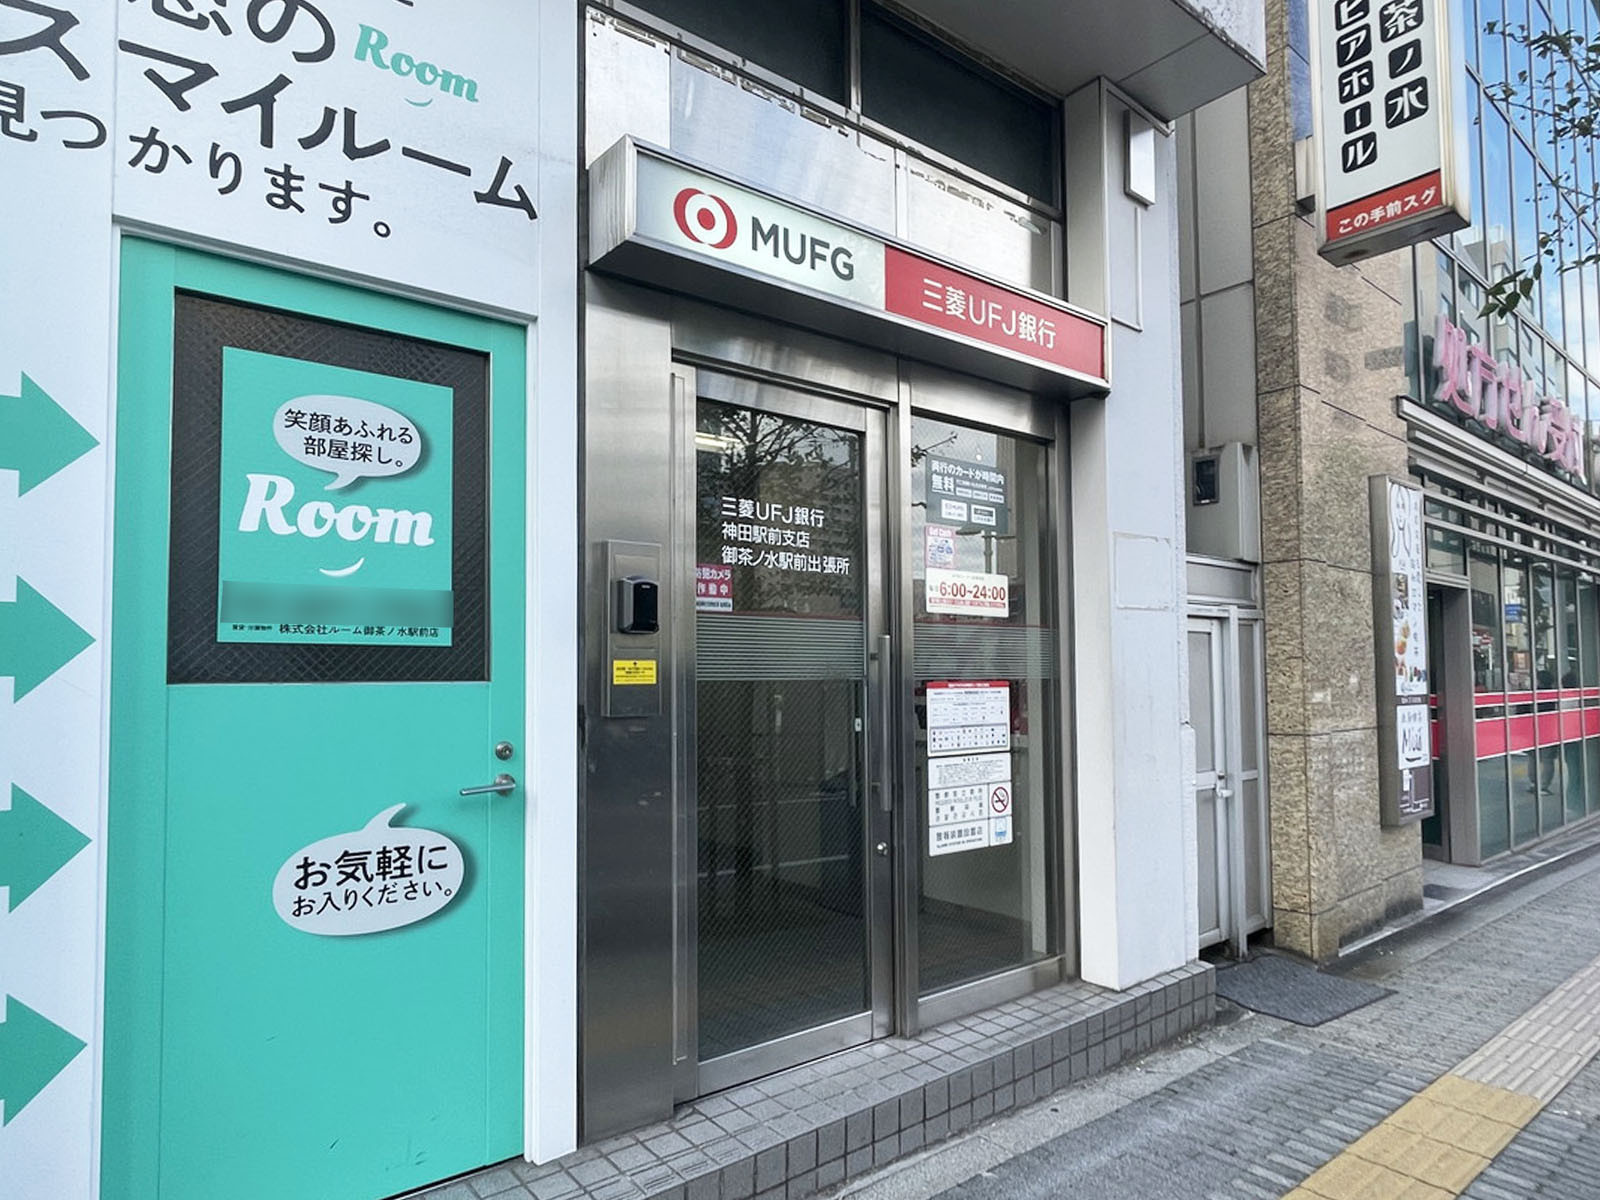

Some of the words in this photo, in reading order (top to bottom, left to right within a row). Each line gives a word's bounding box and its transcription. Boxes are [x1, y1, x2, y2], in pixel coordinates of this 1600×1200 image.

[353, 23, 480, 103] Room
[1338, 186, 1437, 234] この手前スグ
[751, 216, 855, 281] MUFG
[922, 278, 1057, 349] 三菱UFJ銀行
[284, 408, 414, 444] 笑顔あふれる
[303, 436, 404, 468] 部屋探し。
[238, 473, 435, 547] Room
[721, 497, 825, 528] 三菱UFJ銀行
[721, 522, 810, 549] 神田駅前支店
[721, 546, 850, 576] 御茶ノ水駅前出張所
[294, 845, 448, 890] お気軽に
[292, 880, 452, 917] お入りください。
